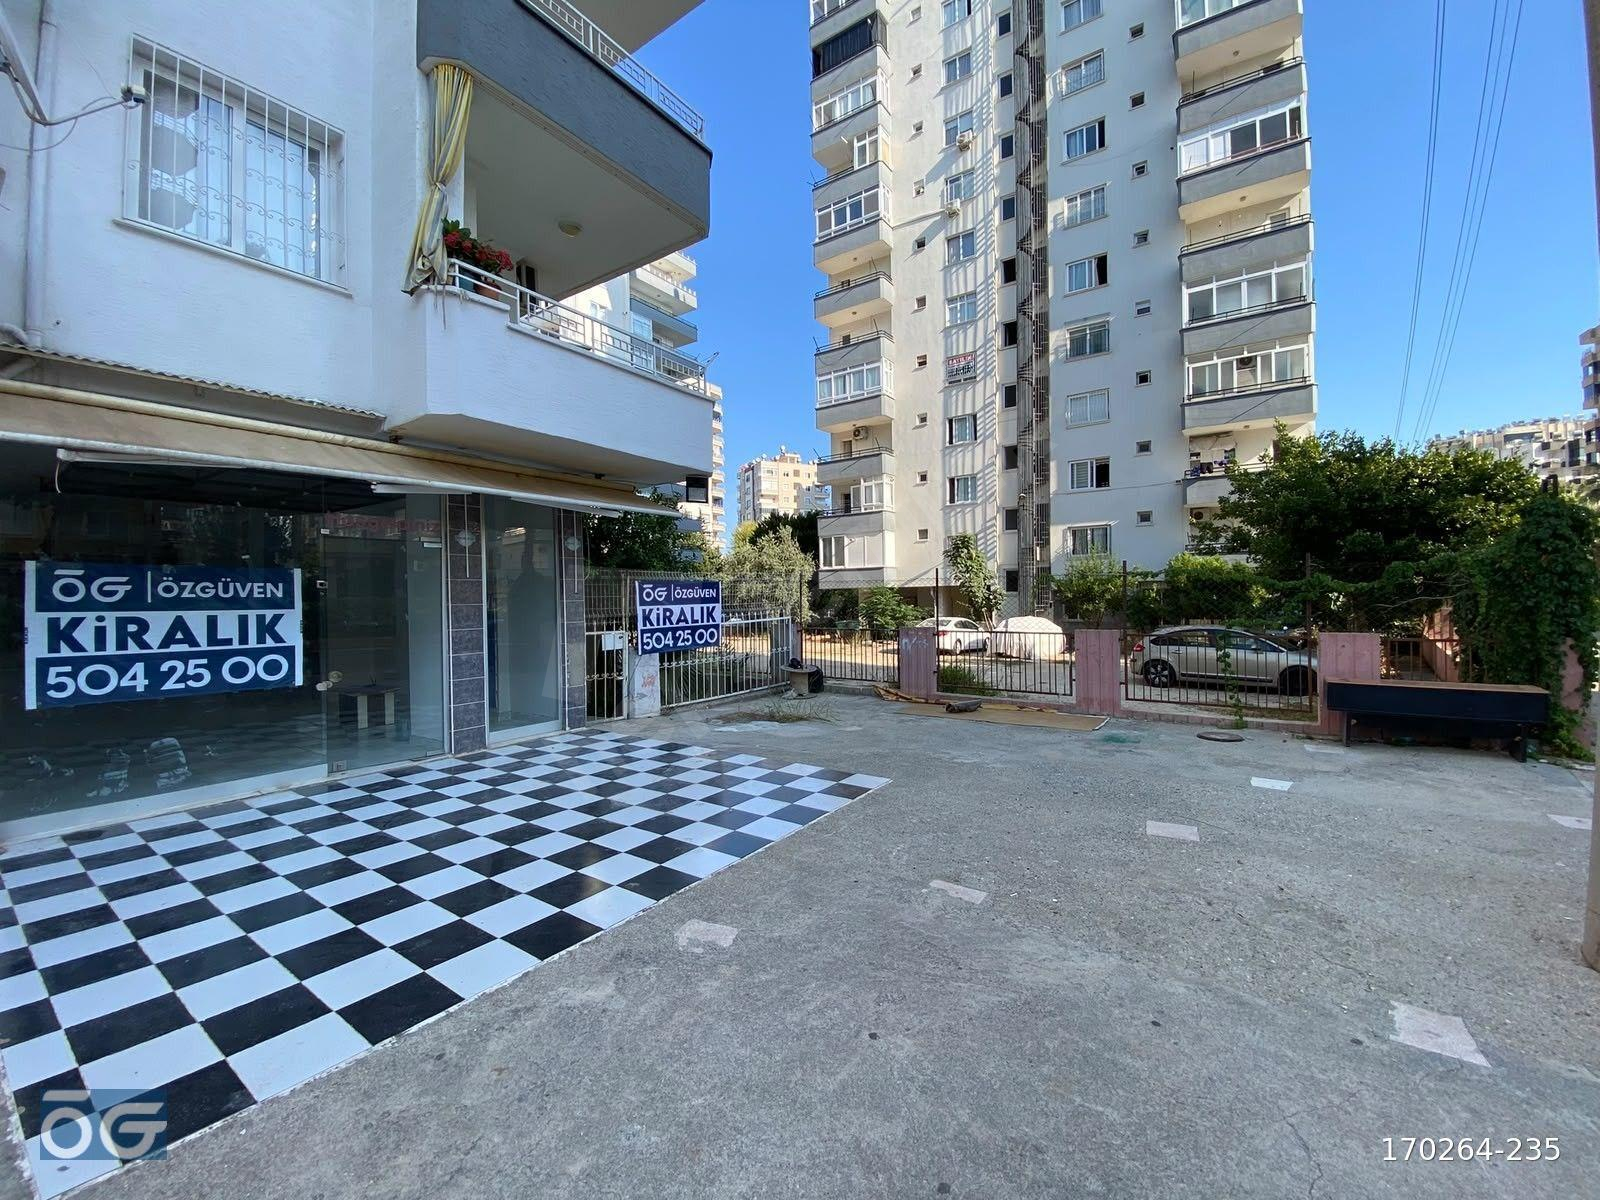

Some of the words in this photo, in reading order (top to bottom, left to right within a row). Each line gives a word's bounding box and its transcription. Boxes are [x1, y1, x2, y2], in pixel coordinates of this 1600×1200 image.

[157, 577, 283, 598] ÖZGÜVEN
[674, 586, 716, 599] ÖZGÜVEN
[643, 631, 674, 650] 504
[676, 630, 692, 647] 25
[695, 628, 718, 644] 00
[46, 662, 149, 699] 504
[160, 658, 211, 691] 25
[221, 654, 289, 684] 00
